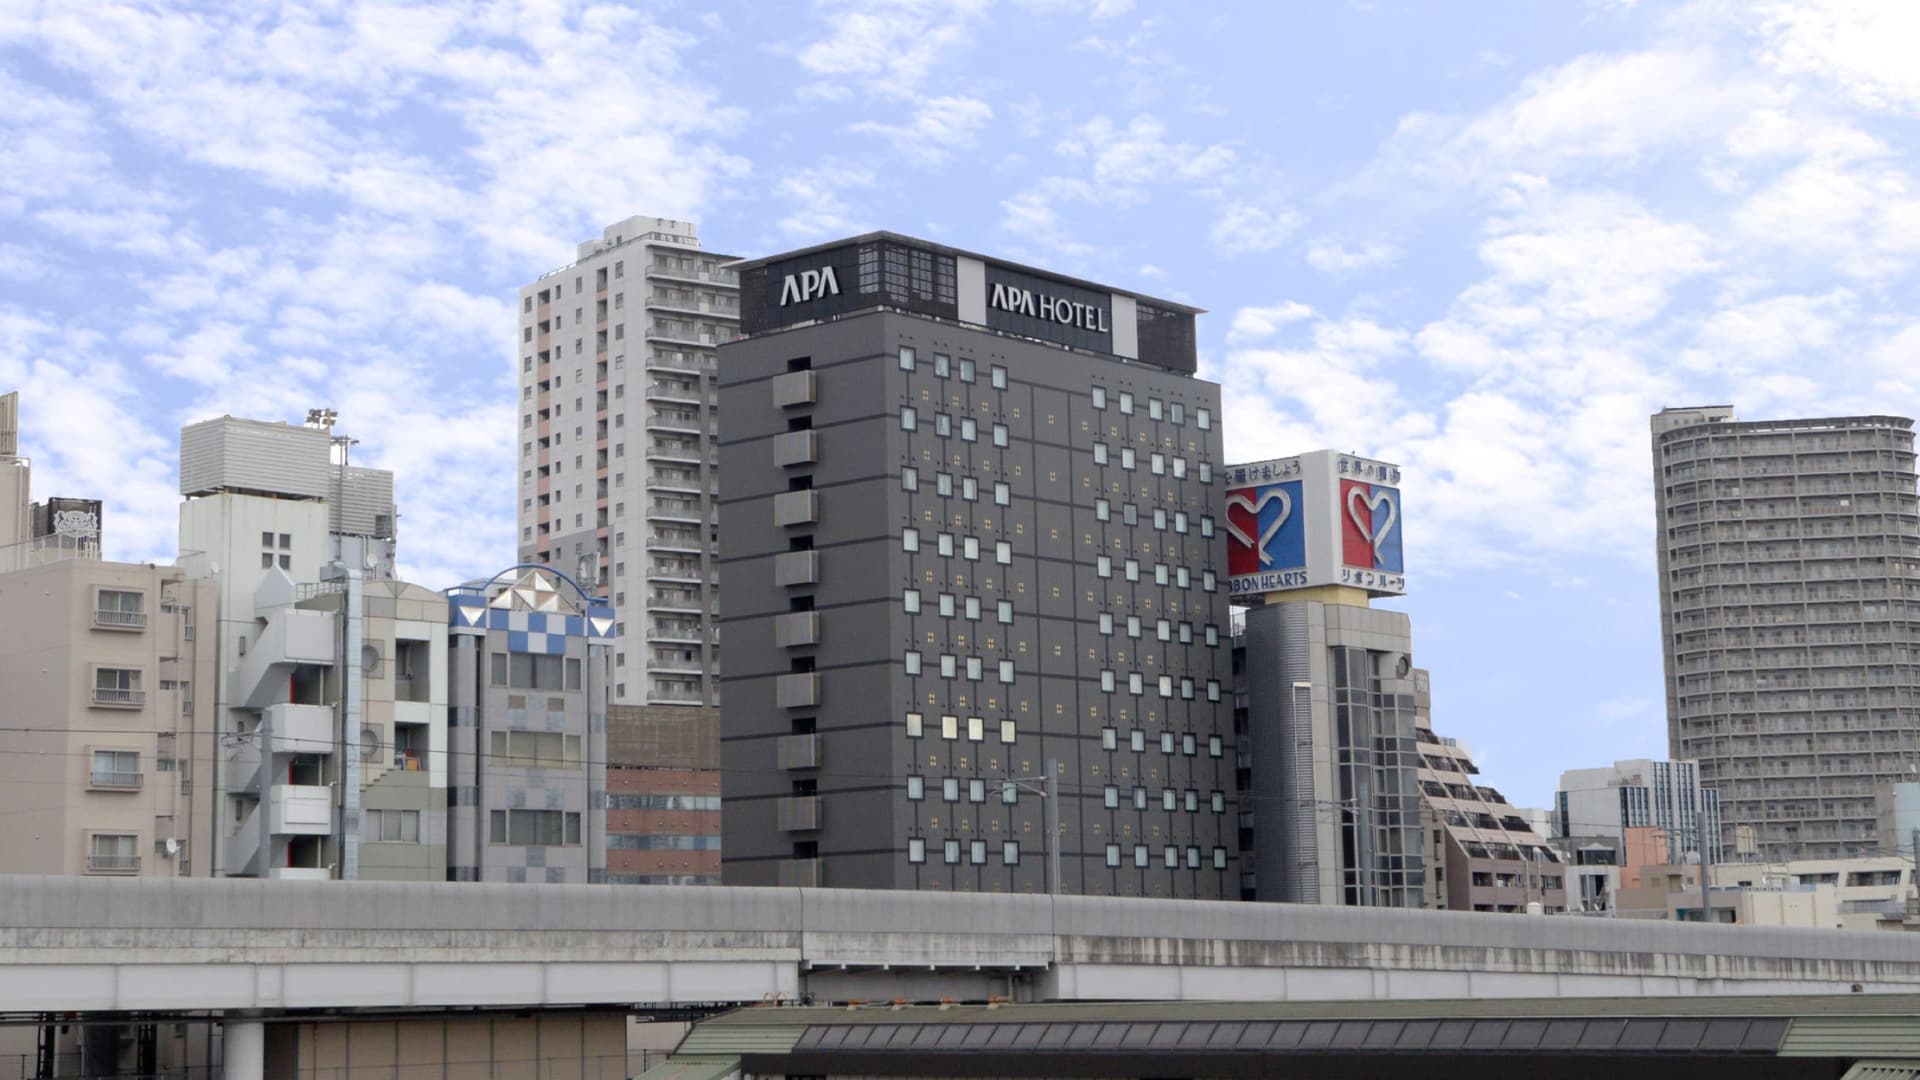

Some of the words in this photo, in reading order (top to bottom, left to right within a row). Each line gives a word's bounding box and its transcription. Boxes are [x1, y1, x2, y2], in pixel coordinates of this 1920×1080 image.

[780, 265, 839, 306] APA
[992, 283, 1035, 316] APA
[1040, 293, 1109, 333] HOTEL
[1261, 571, 1308, 589] HEARTS
